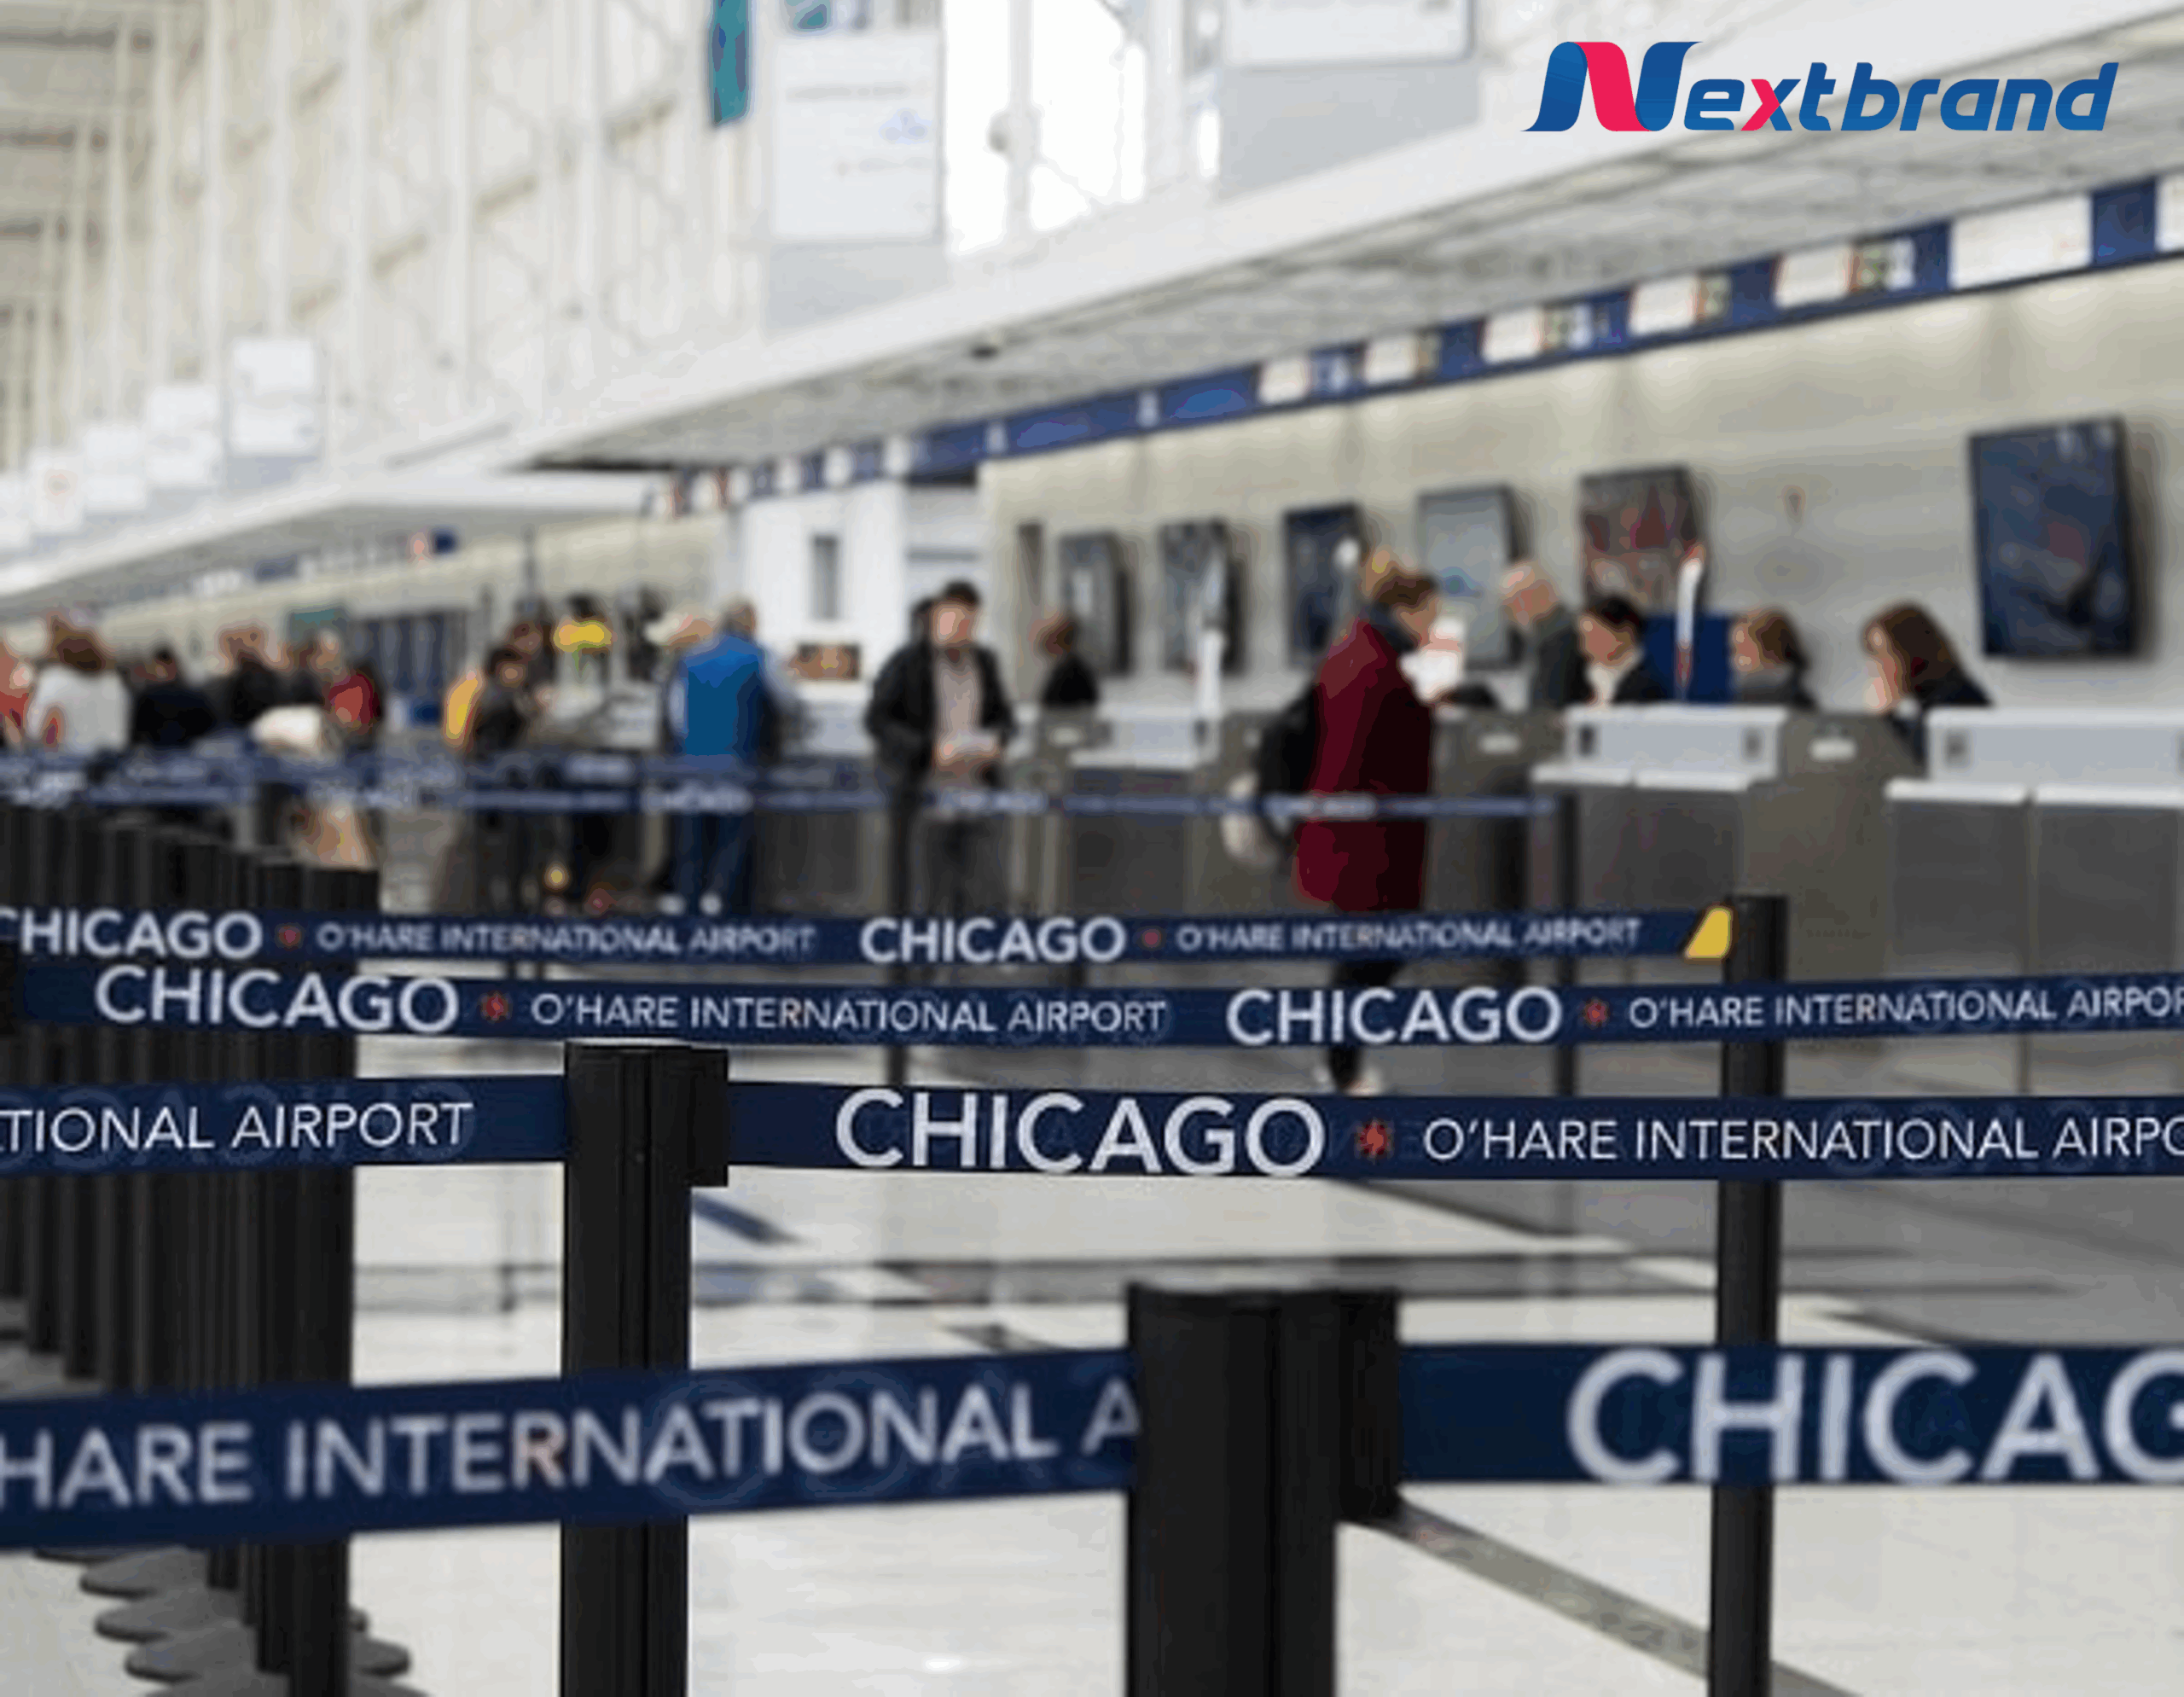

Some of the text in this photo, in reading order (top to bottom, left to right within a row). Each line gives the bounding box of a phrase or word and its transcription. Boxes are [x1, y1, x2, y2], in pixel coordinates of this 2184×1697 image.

[316, 922, 433, 952] O'HARE
[440, 924, 682, 954] INTERNATIONAL
[688, 925, 816, 954] AIRPORT
[860, 915, 1126, 963] CHICAGO
[1176, 922, 1283, 952] O'HARE
[1292, 921, 1515, 950] INTERNATIONAL
[1524, 916, 1641, 946] AIRPORT
[96, 964, 460, 1034] CHICAGO
[531, 992, 679, 1028] O'HARE
[691, 997, 997, 1032] INTERNATIONAL
[1008, 1000, 1167, 1032] AIRPORT
[1225, 986, 1563, 1045] CHICAGO
[1629, 996, 1764, 1029] O'HARE
[1774, 989, 2058, 1026] INTERNATIONAL
[231, 1101, 473, 1148] AIRPORT
[835, 1088, 1326, 1177] CHICAGO
[1423, 1118, 1618, 1160] O'HARE
[1636, 1118, 2039, 1160] INTERNATIONAL
[287, 1382, 1060, 1502] INTERNATIONAL
